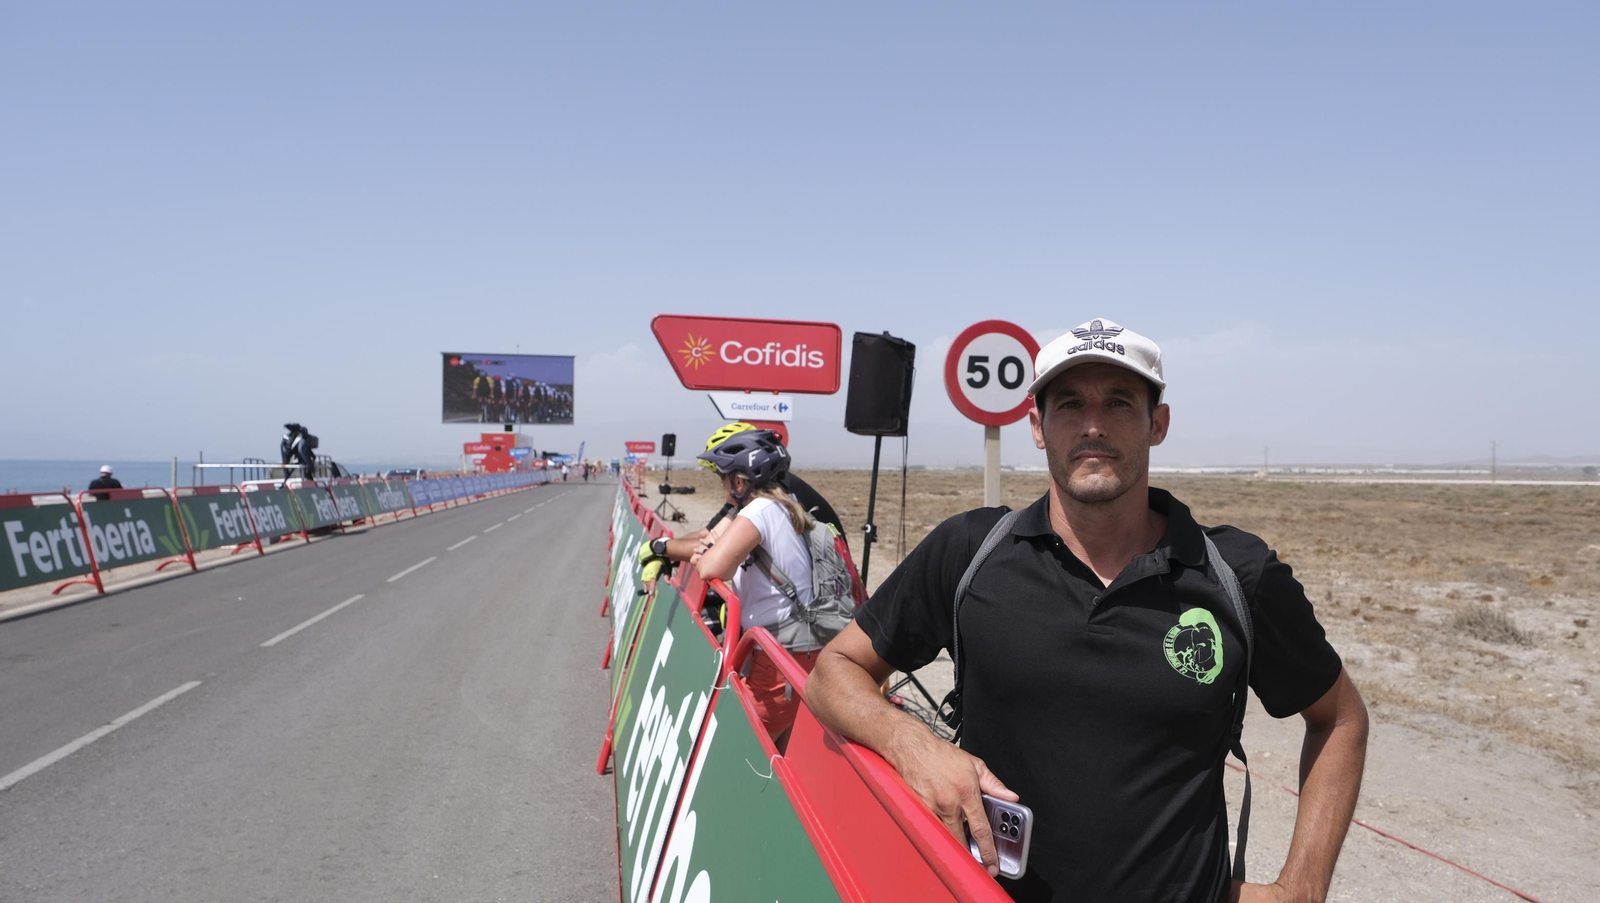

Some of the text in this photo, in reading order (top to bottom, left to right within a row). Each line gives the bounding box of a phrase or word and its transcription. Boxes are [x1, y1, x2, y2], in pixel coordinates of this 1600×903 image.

[719, 340, 825, 369] Cofidis
[1066, 339, 1126, 356] adidas
[966, 355, 1025, 390] 50
[730, 402, 770, 412] Carrefour
[3, 508, 156, 578] Fertiberia
